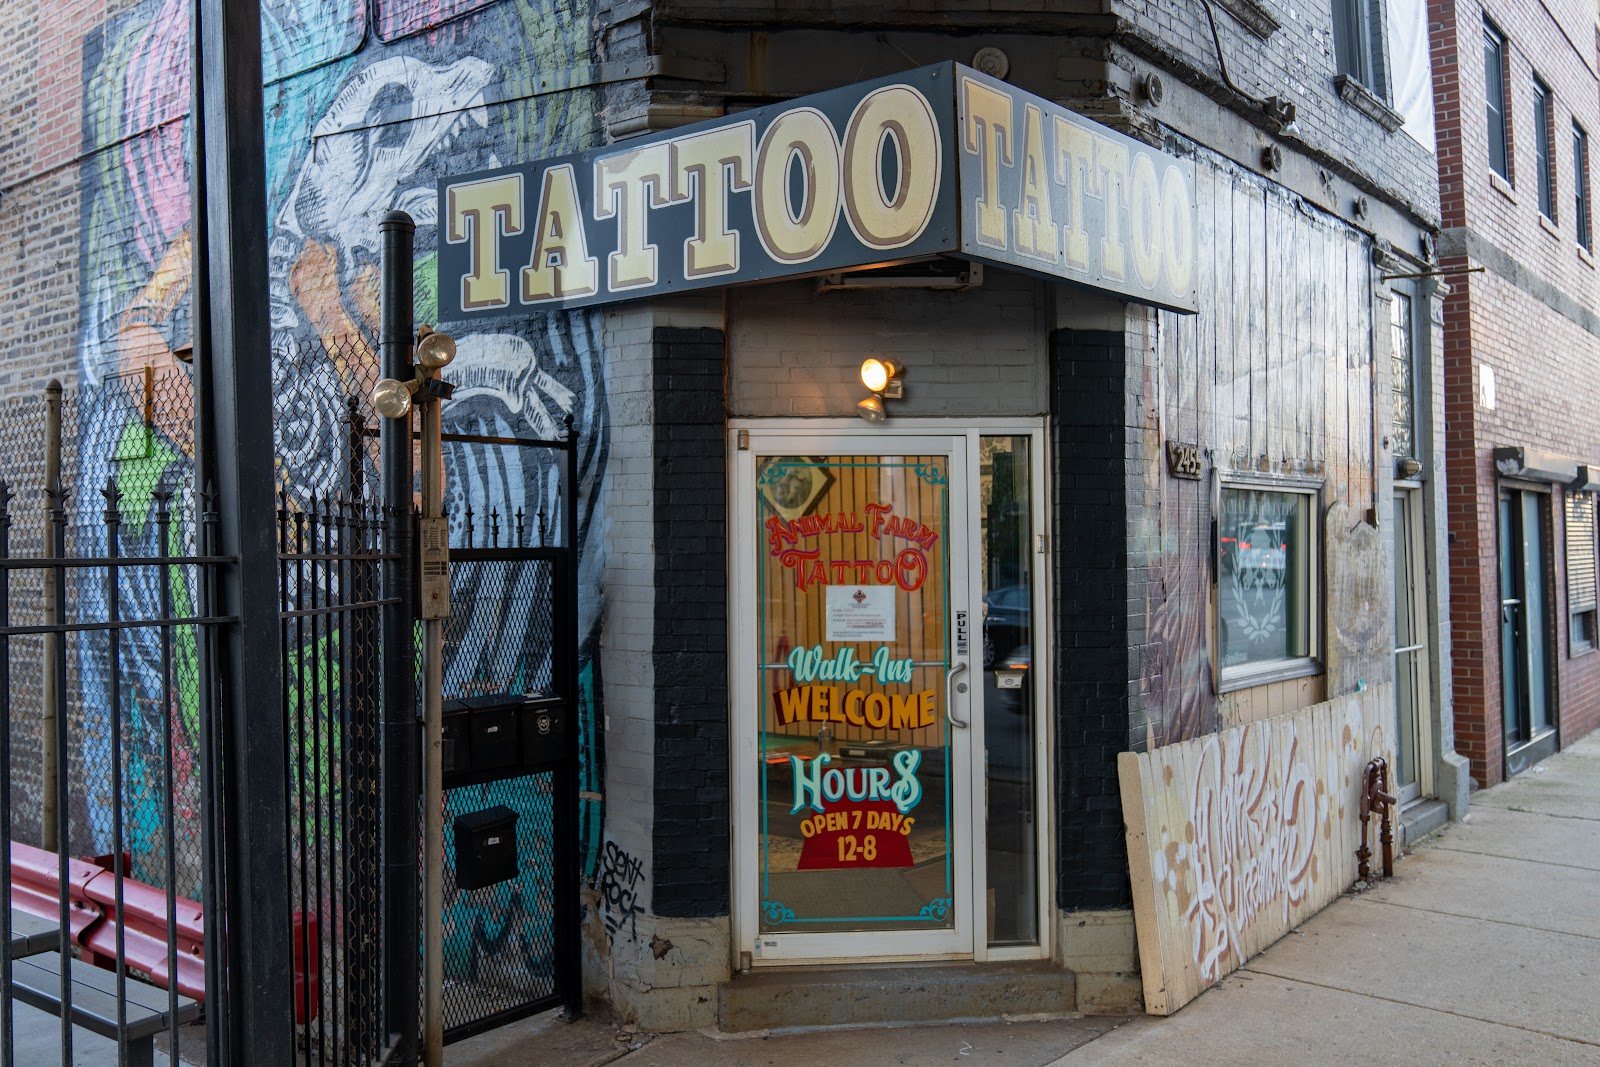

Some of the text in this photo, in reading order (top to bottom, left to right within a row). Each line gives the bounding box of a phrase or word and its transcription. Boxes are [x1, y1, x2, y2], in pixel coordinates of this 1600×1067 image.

[446, 84, 943, 312] TATTOO
[961, 75, 1193, 298] TATTOO
[765, 503, 939, 557] ANIMAL FARM
[780, 548, 929, 592] TATTOO
[956, 613, 967, 641] PULL
[787, 644, 915, 684] Walk-Ins
[773, 685, 936, 731] WELCOME
[789, 750, 923, 815] HOURS
[800, 810, 916, 838] OPEN 7 DAYS
[836, 834, 878, 861] 12-8
